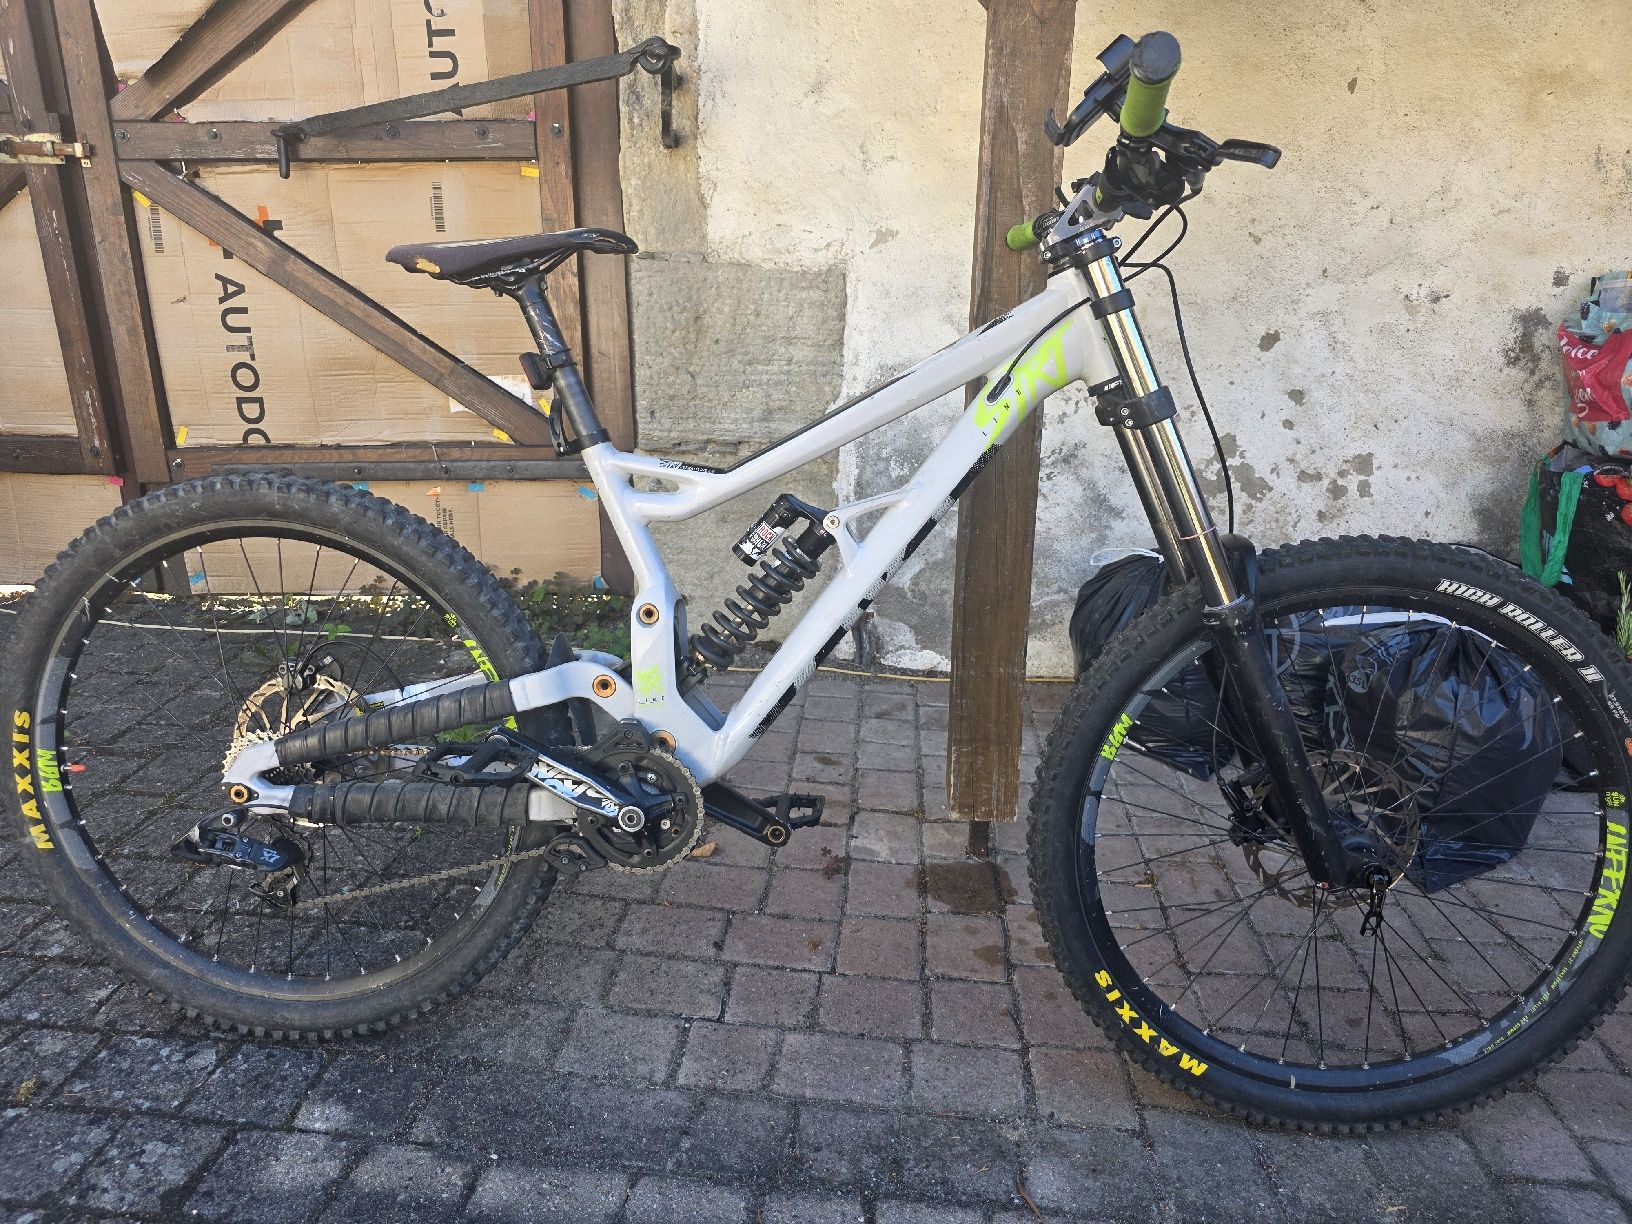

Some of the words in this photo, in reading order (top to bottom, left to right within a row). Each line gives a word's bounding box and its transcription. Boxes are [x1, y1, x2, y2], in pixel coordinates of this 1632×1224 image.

[1435, 578, 1503, 608] HIGH
[1498, 601, 1585, 662] ROLLER
[12, 709, 55, 849] MAXXIS
[1094, 969, 1208, 1076] MAXXIS
